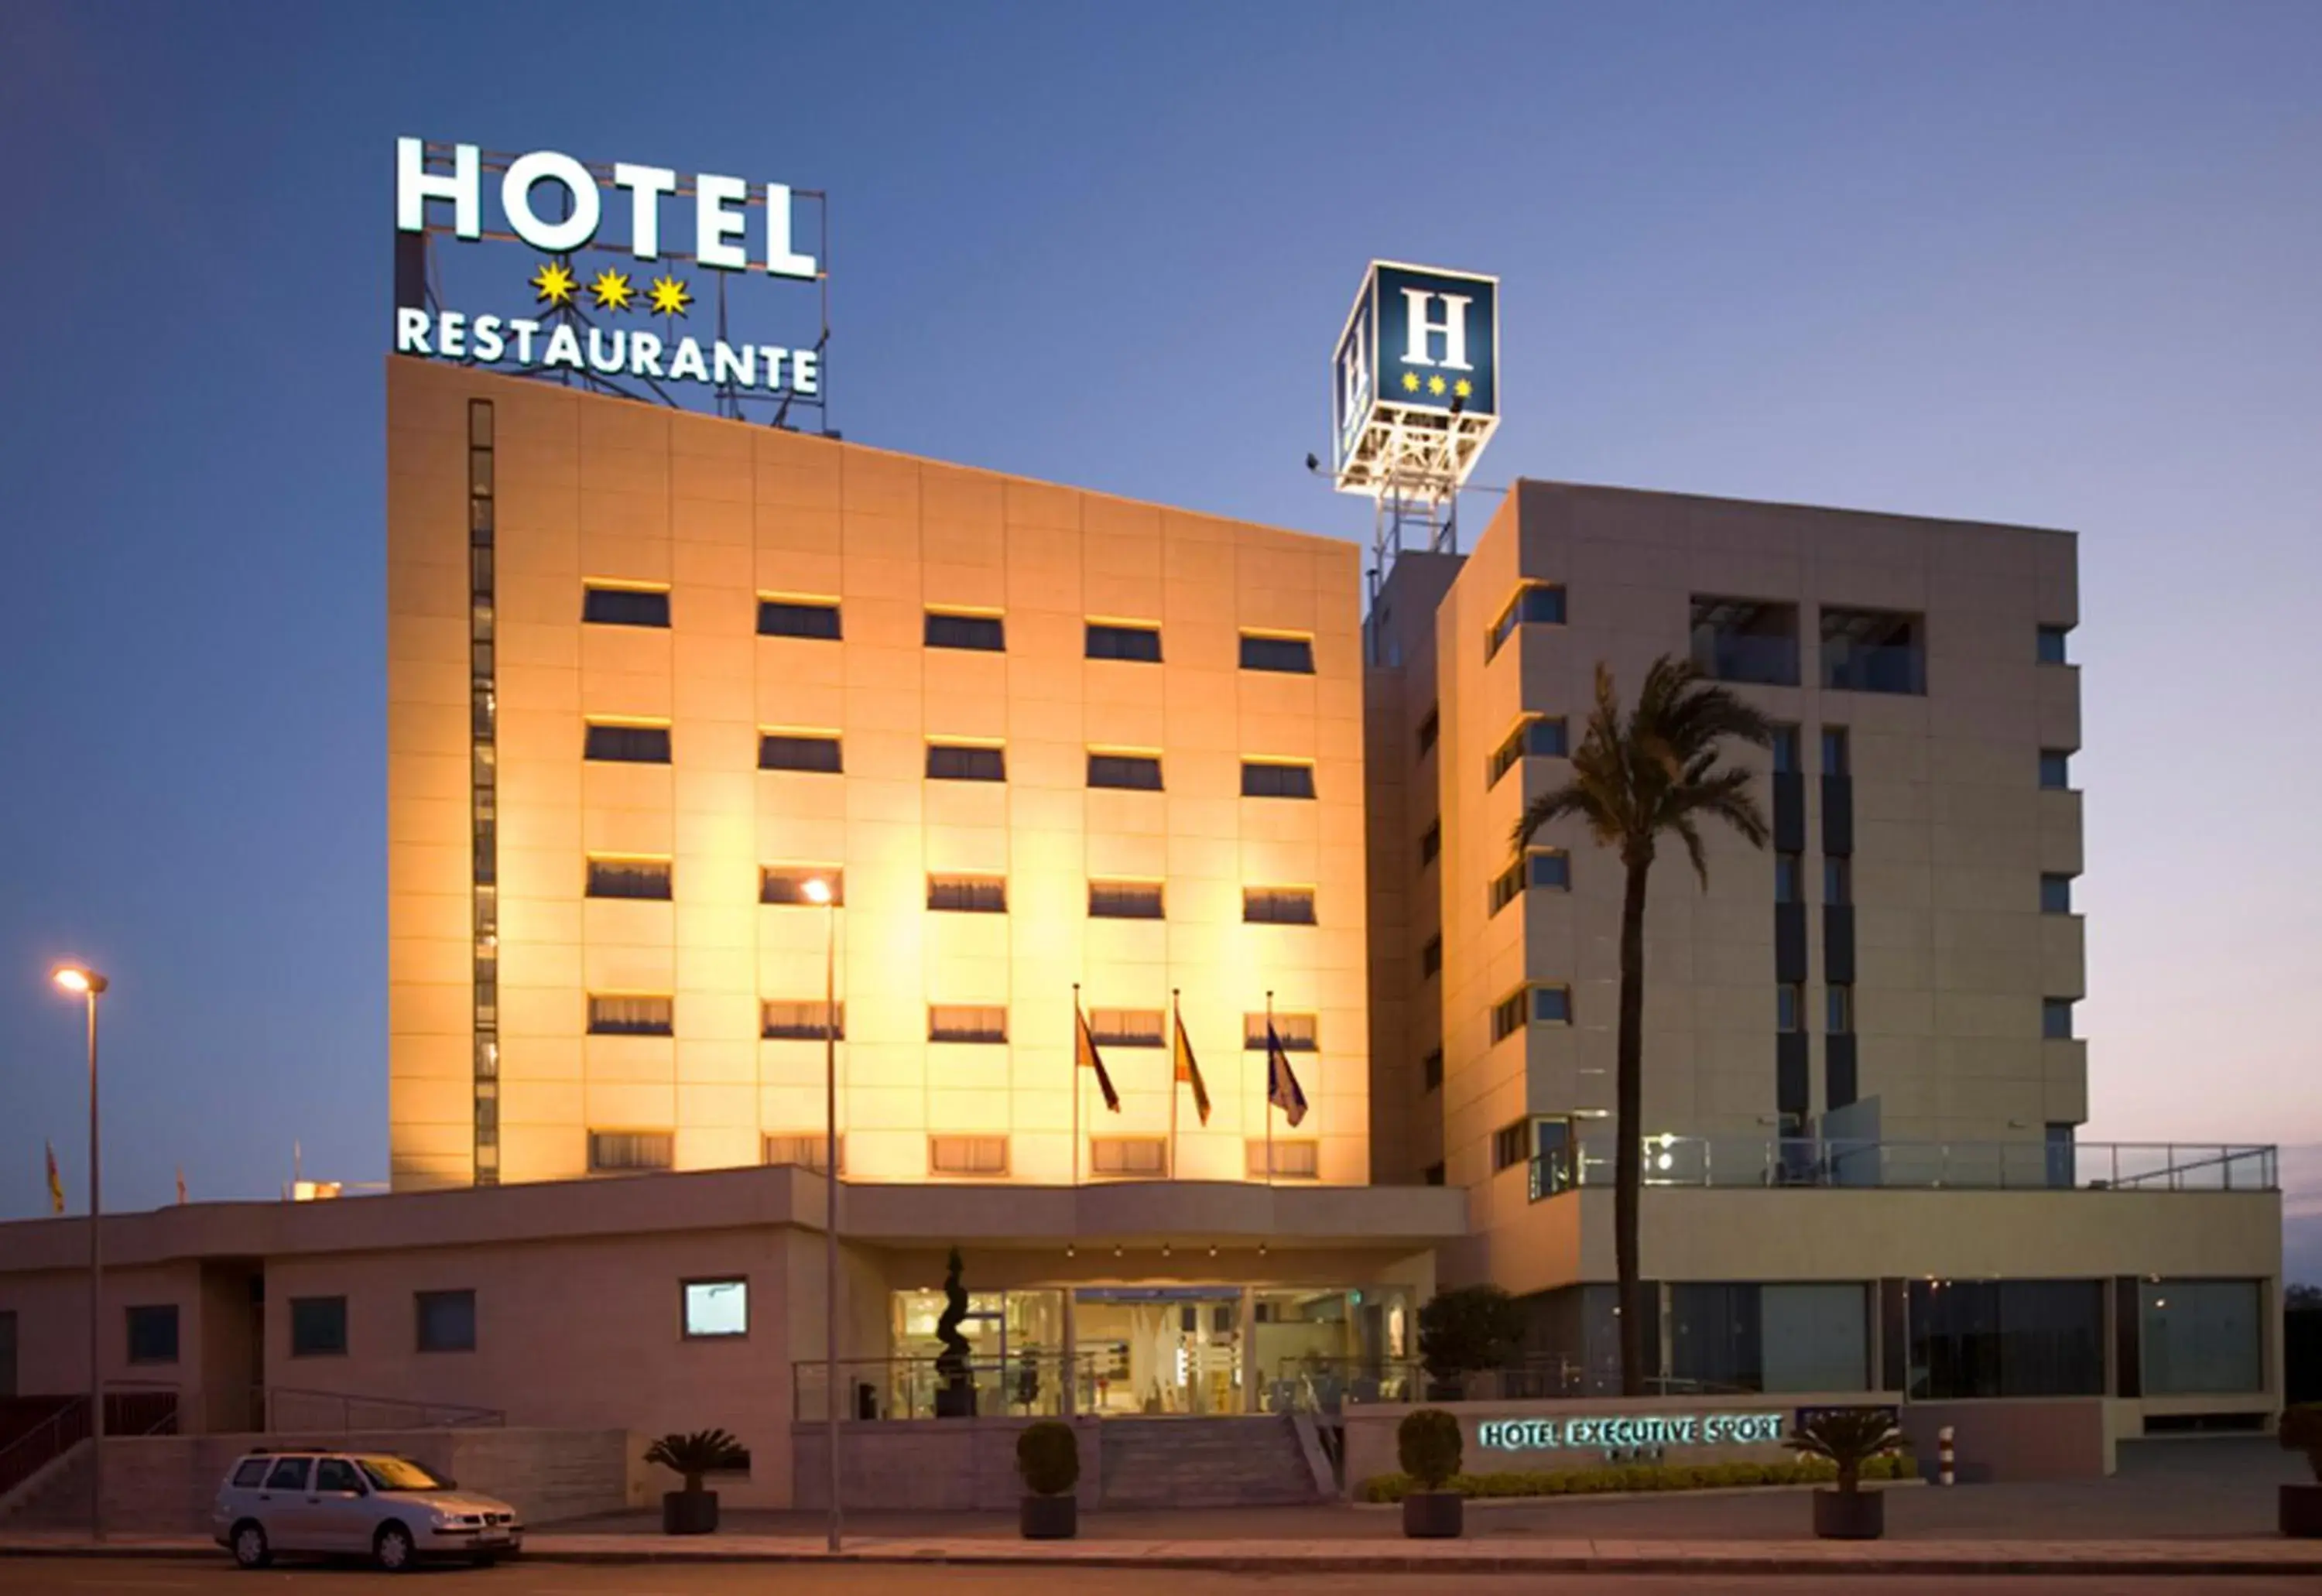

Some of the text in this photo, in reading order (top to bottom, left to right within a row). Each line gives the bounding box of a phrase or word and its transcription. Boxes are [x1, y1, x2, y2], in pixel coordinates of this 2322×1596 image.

[397, 136, 817, 279] HOTEL
[396, 307, 817, 394] RESTAURANTE
[1399, 287, 1474, 371] H
[1480, 1421, 1560, 1449] HOTEL
[1565, 1417, 1698, 1445] EXECUTIVE
[1704, 1414, 1784, 1442] SPORT
